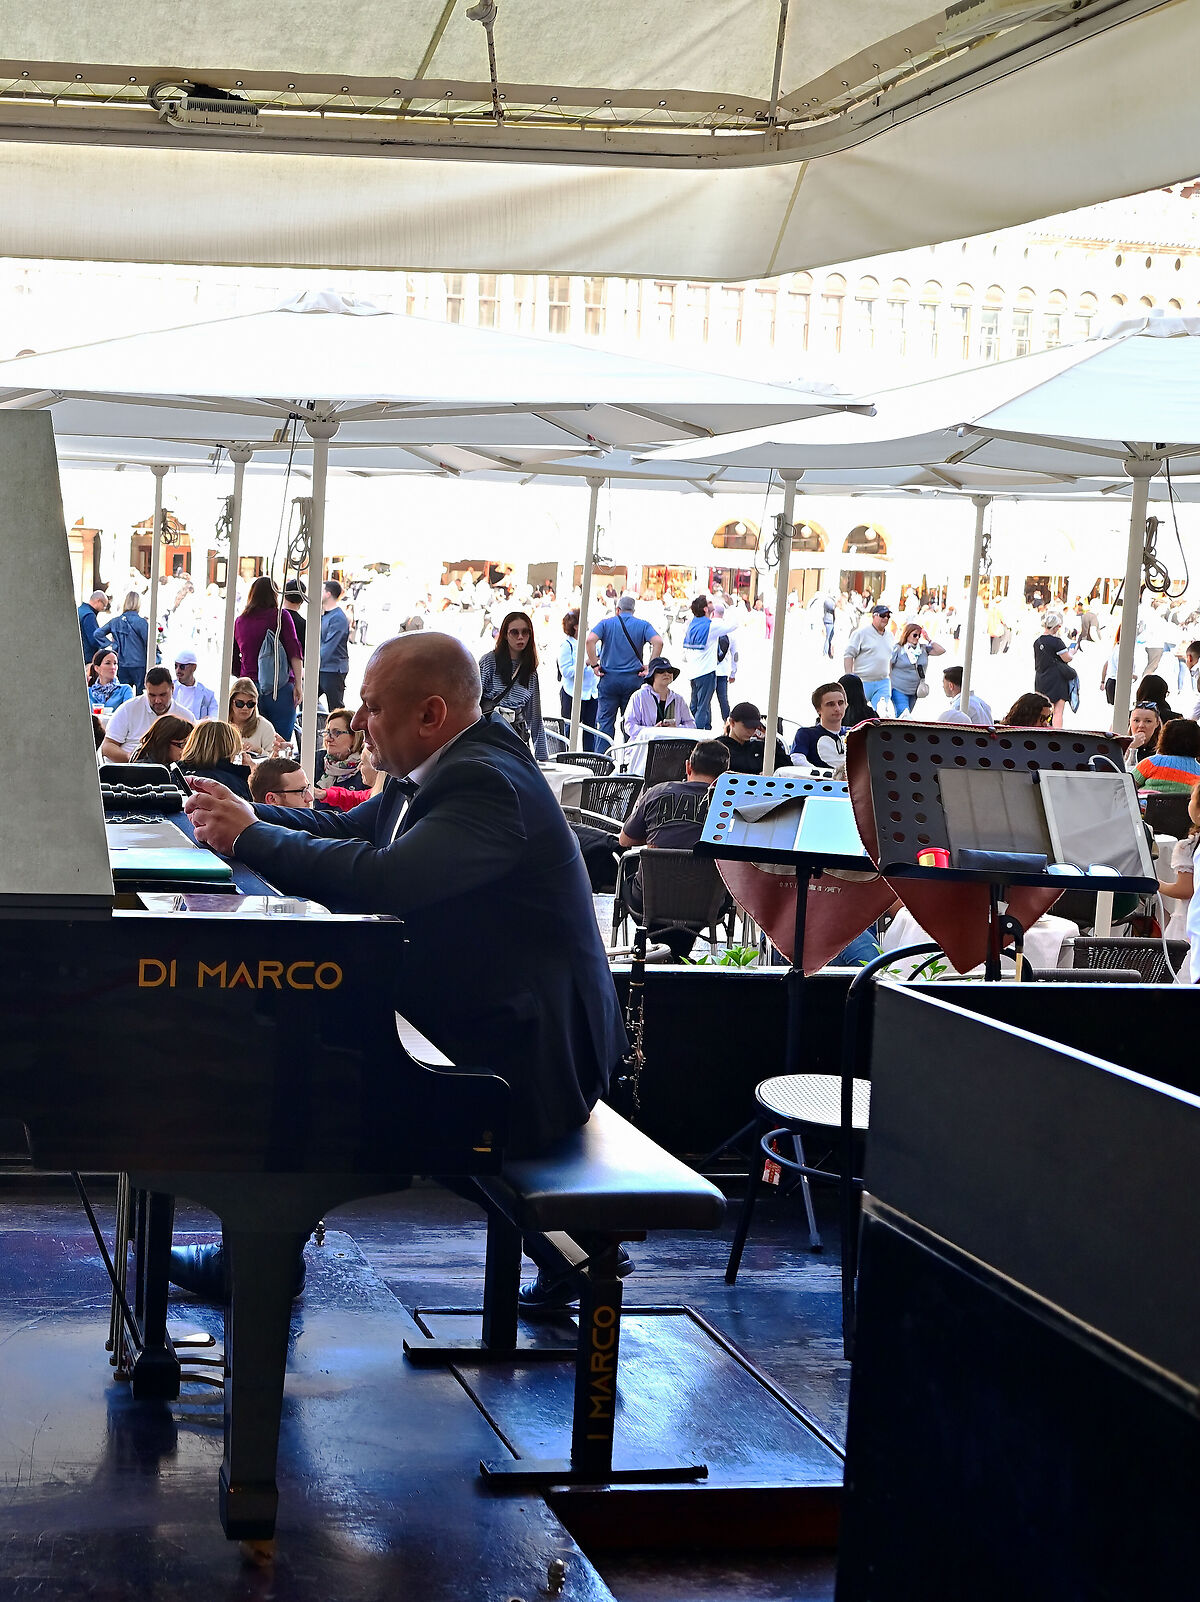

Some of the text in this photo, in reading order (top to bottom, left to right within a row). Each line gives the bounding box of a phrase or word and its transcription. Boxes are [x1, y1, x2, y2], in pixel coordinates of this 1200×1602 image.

[138, 958, 343, 990] DI MARCO
[588, 1305, 616, 1419] MARCO
